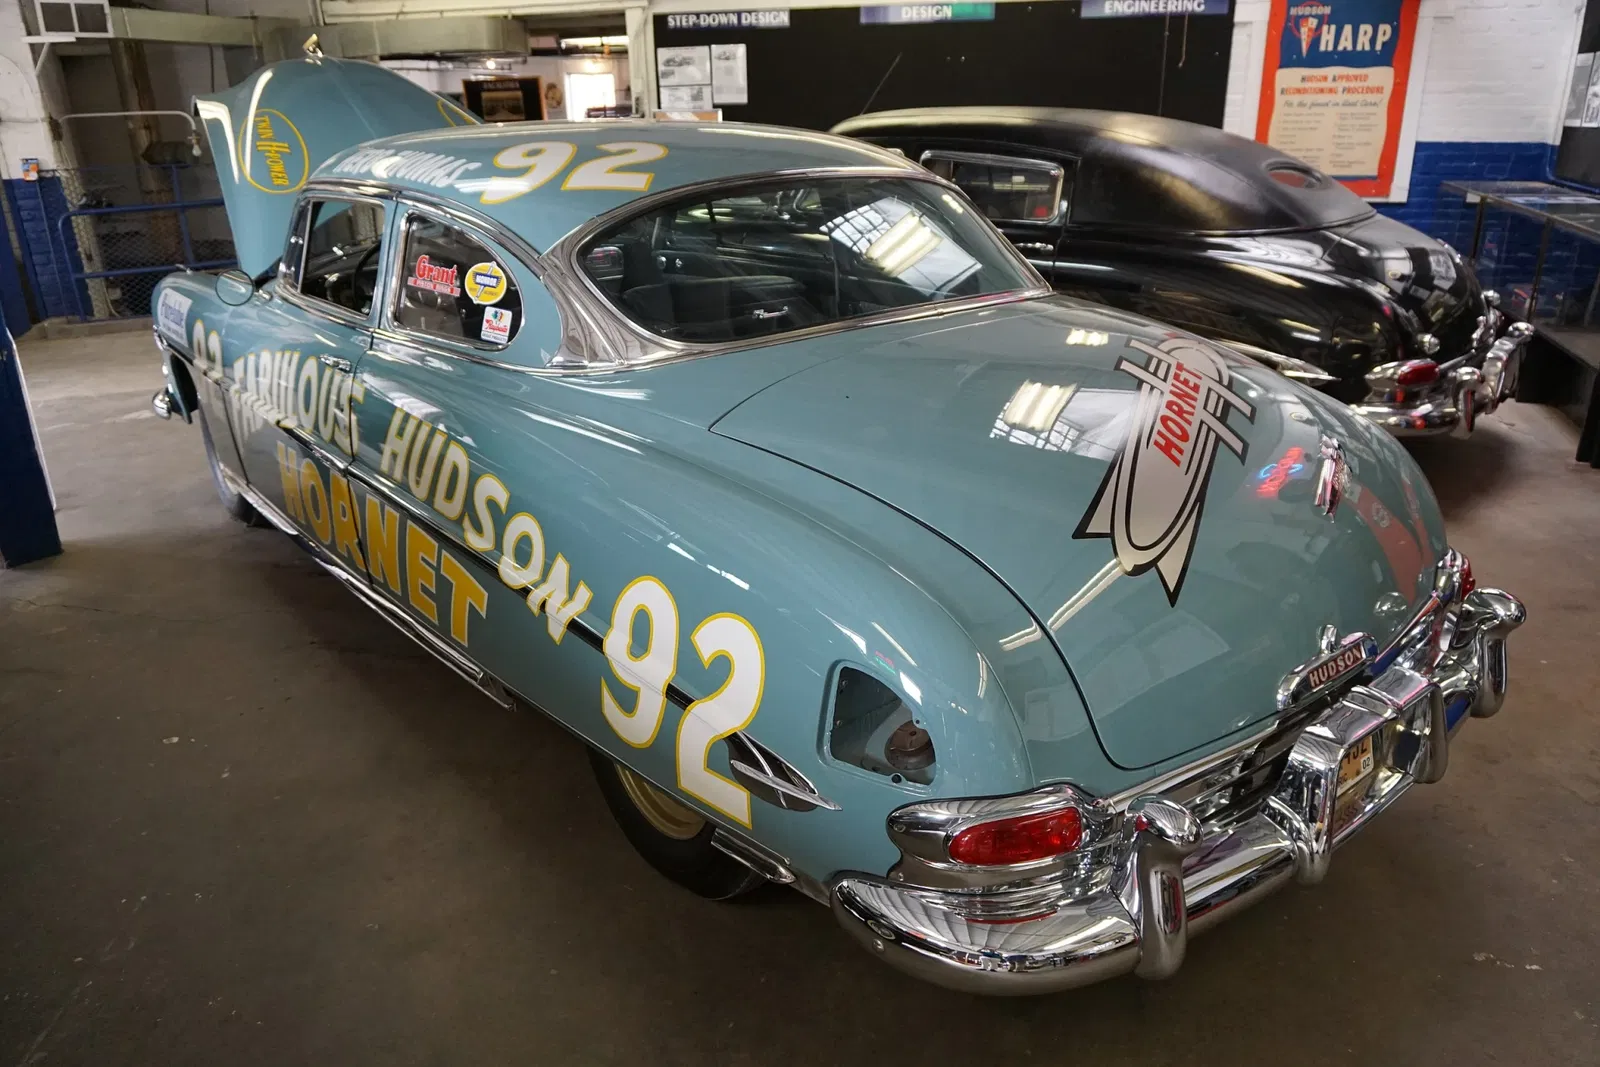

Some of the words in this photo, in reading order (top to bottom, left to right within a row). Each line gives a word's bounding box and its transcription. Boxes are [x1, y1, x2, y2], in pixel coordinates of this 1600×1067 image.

[667, 12, 738, 28] STEP-DOWN
[740, 10, 789, 26] DESIGN
[901, 4, 953, 20] DESIGN
[1104, 0, 1206, 13] ENGINEERING
[1290, 5, 1332, 16] HUDSON
[1319, 23, 1392, 52] HARP
[1280, 87, 1338, 95] RECONDITIONING
[1342, 86, 1384, 95] PROCEDURE
[1300, 75, 1328, 83] HUDSON
[1332, 73, 1369, 82] APPROVED
[255, 115, 274, 139] TWIN
[480, 141, 669, 205] 92
[416, 254, 457, 286] Grant
[1153, 361, 1203, 468] HORNET
[230, 349, 365, 457] FABULOUS
[380, 407, 594, 646] HUDSON
[276, 440, 488, 648] HORNET
[1308, 644, 1364, 688] HUDSON
[601, 575, 765, 830] 92
[1362, 756, 1371, 770] 02
